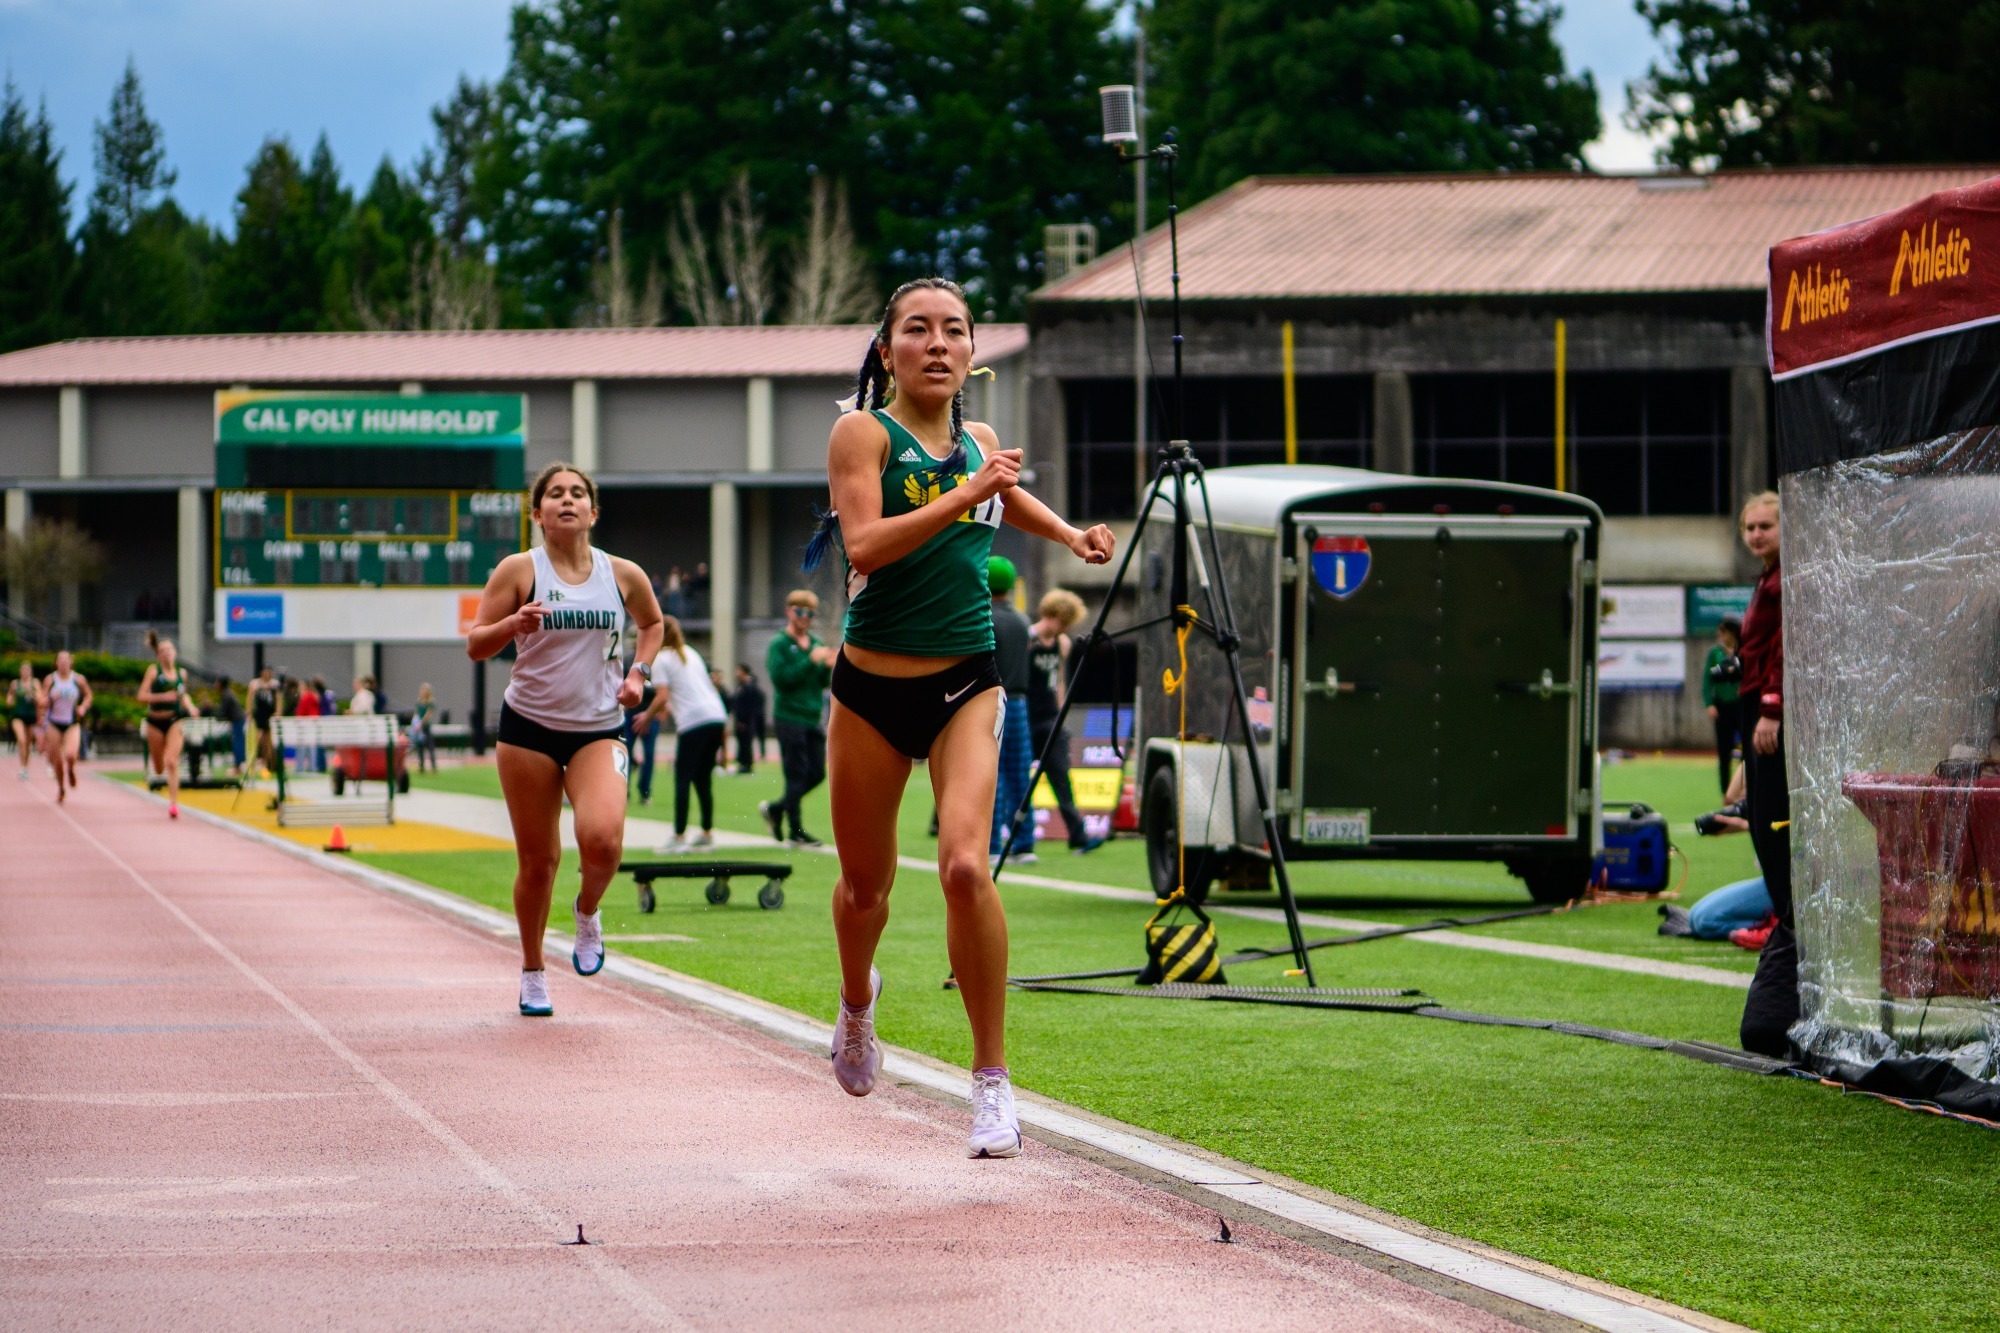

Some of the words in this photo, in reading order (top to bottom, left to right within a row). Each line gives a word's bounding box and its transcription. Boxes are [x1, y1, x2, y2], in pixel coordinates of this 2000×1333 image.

[1889, 218, 1970, 297] Athletic
[1781, 262, 1850, 331] Athletic
[243, 408, 290, 432] CAL
[295, 409, 356, 432] POLY
[362, 411, 499, 434] HUMBOLDT
[221, 492, 267, 514] HOME
[470, 492, 521, 514] GUEST
[263, 540, 304, 560] DOWN
[543, 610, 617, 631] HUMBOLDT
[607, 630, 620, 661] 2
